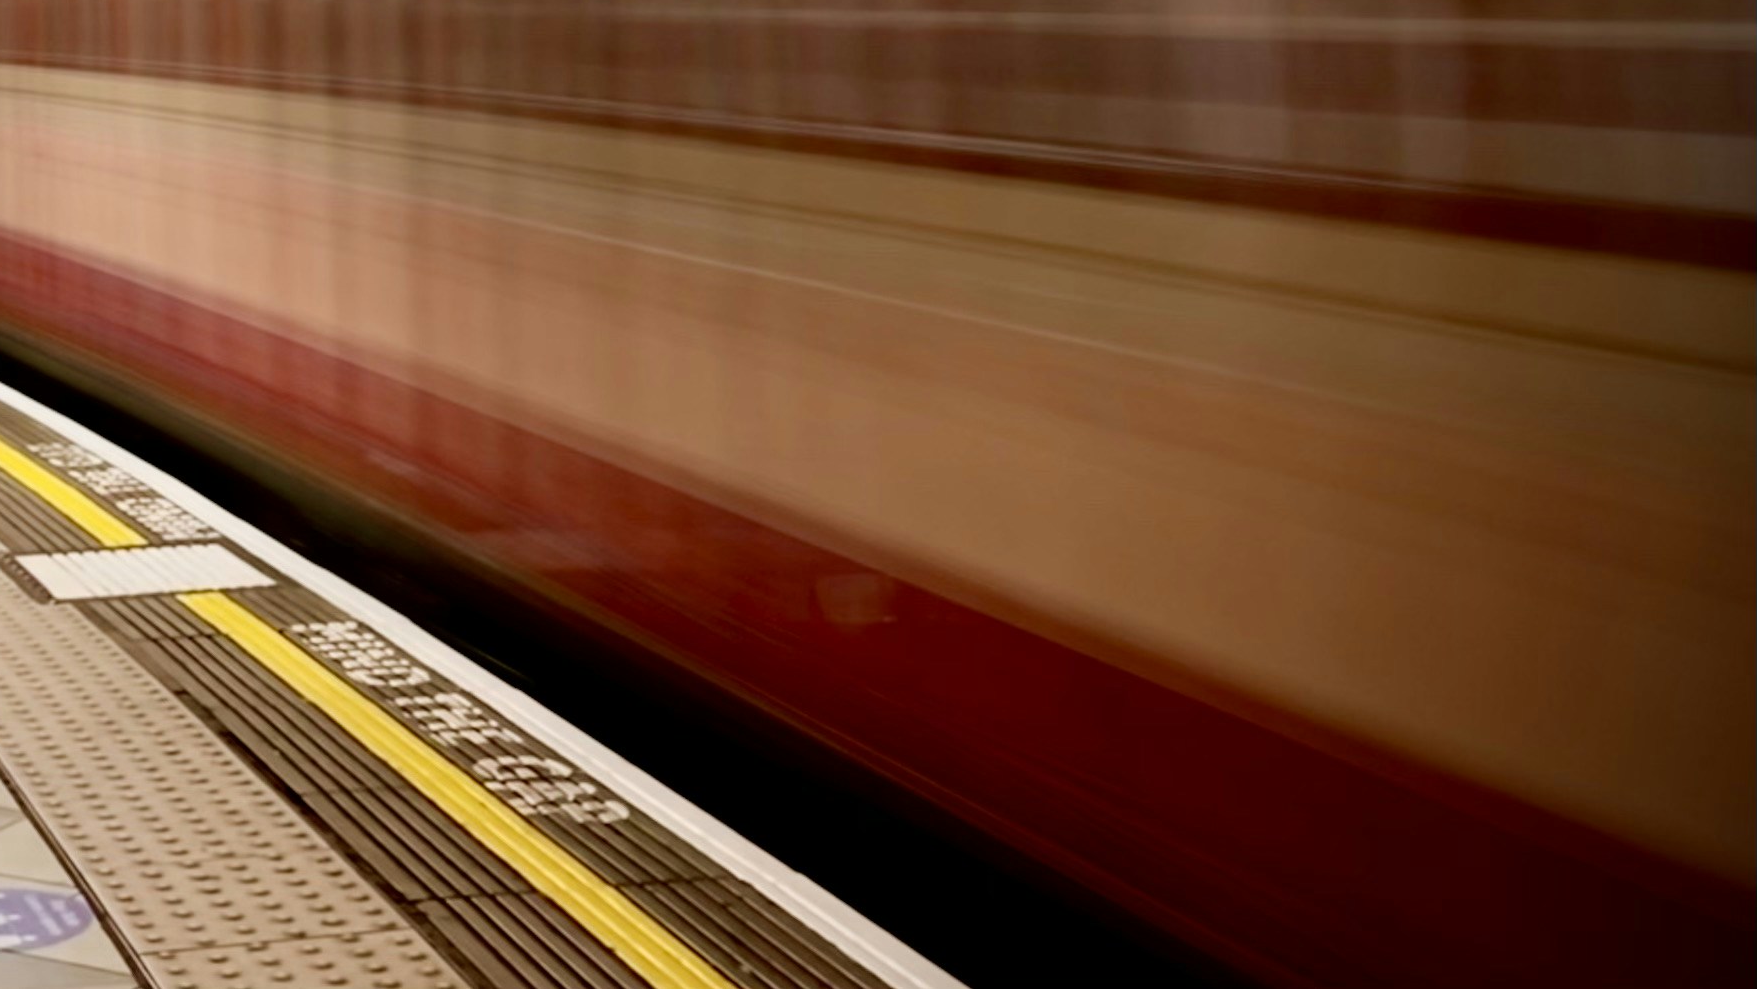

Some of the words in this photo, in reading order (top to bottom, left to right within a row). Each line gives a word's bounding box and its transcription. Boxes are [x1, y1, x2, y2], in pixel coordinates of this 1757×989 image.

[291, 620, 431, 688] MIND
[395, 692, 525, 747] THE
[472, 755, 632, 825] GAP
